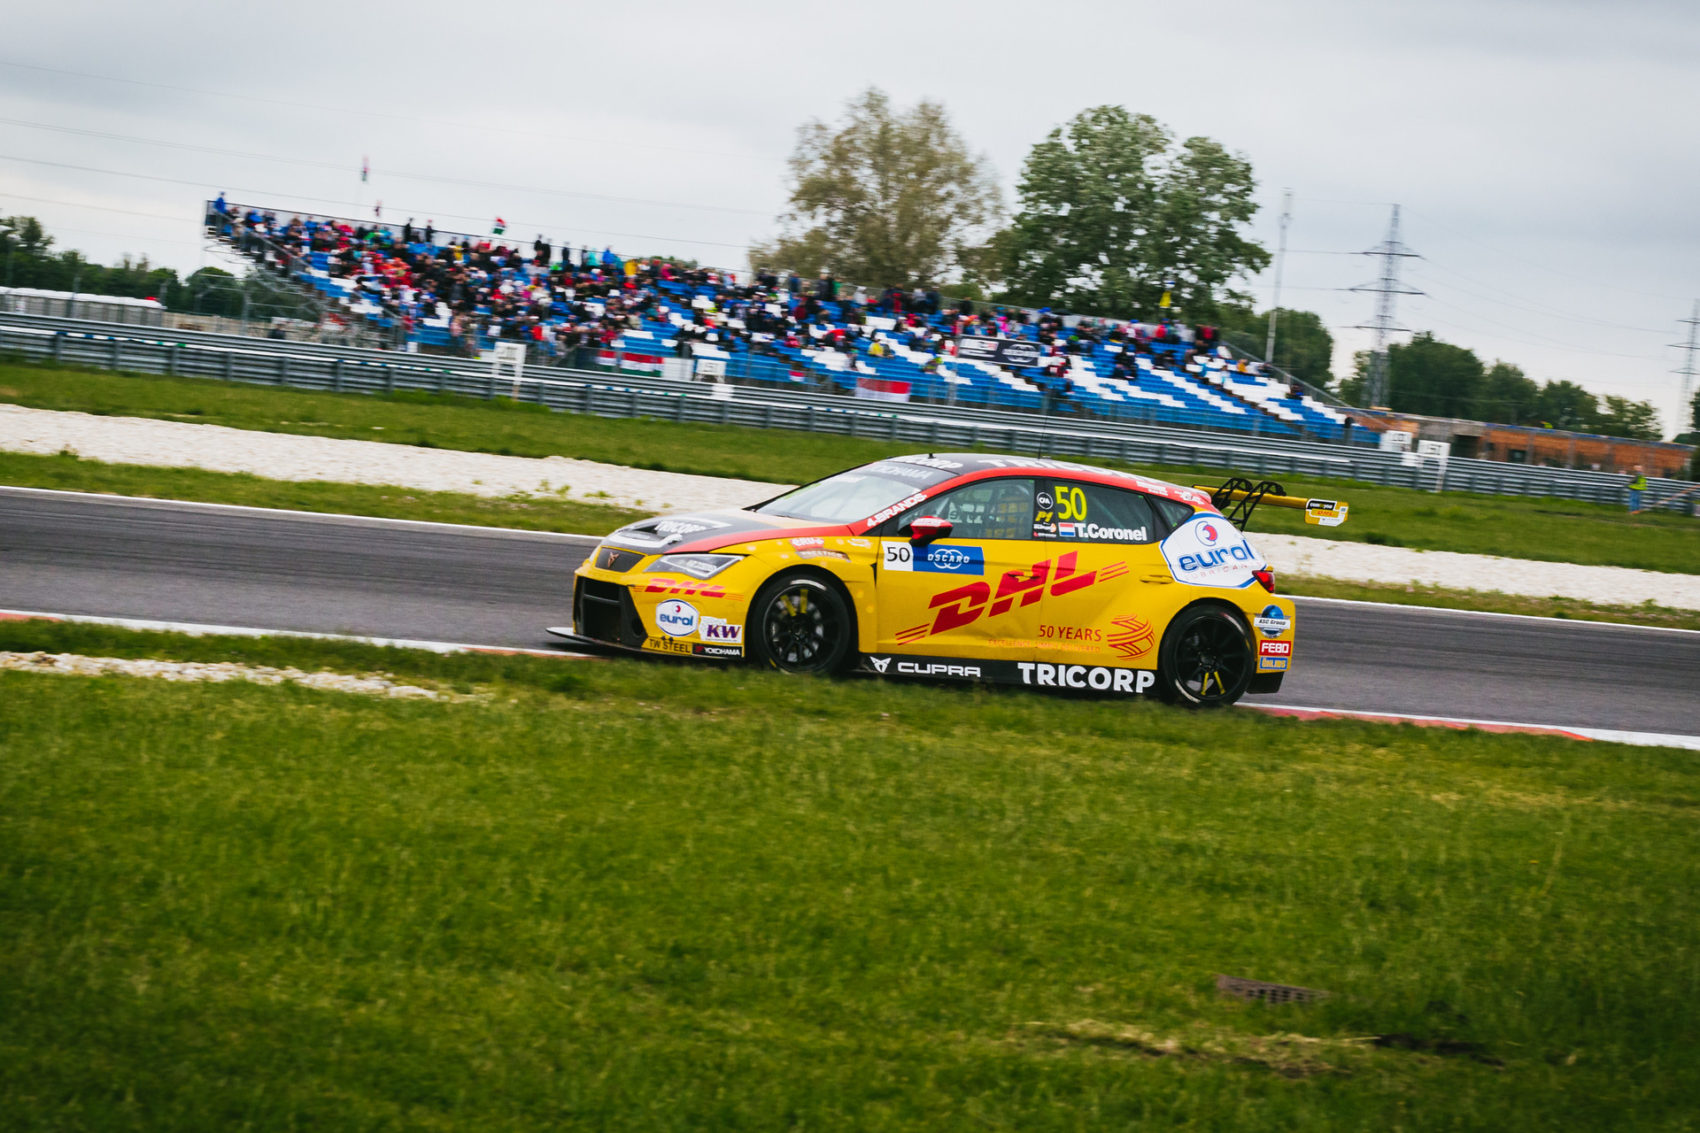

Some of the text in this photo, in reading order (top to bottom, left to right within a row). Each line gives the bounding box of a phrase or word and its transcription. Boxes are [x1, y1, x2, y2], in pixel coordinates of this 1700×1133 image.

[1054, 485, 1088, 521] 50
[1074, 522, 1148, 541] T.Coronel
[887, 546, 911, 563] 50
[927, 553, 971, 564] OSCARO
[1178, 539, 1256, 572] eurol
[644, 578, 726, 599] DHL
[927, 550, 1098, 636] DHL
[659, 613, 694, 627] eurol
[706, 624, 741, 639] KW
[1038, 624, 1103, 642] 50 YEARS
[648, 638, 691, 654] TW STEEL
[703, 646, 741, 656] YOKOHAMA
[1261, 641, 1290, 654] FEBO
[897, 661, 982, 678] CUPRA
[1016, 662, 1157, 694] TRICORP
